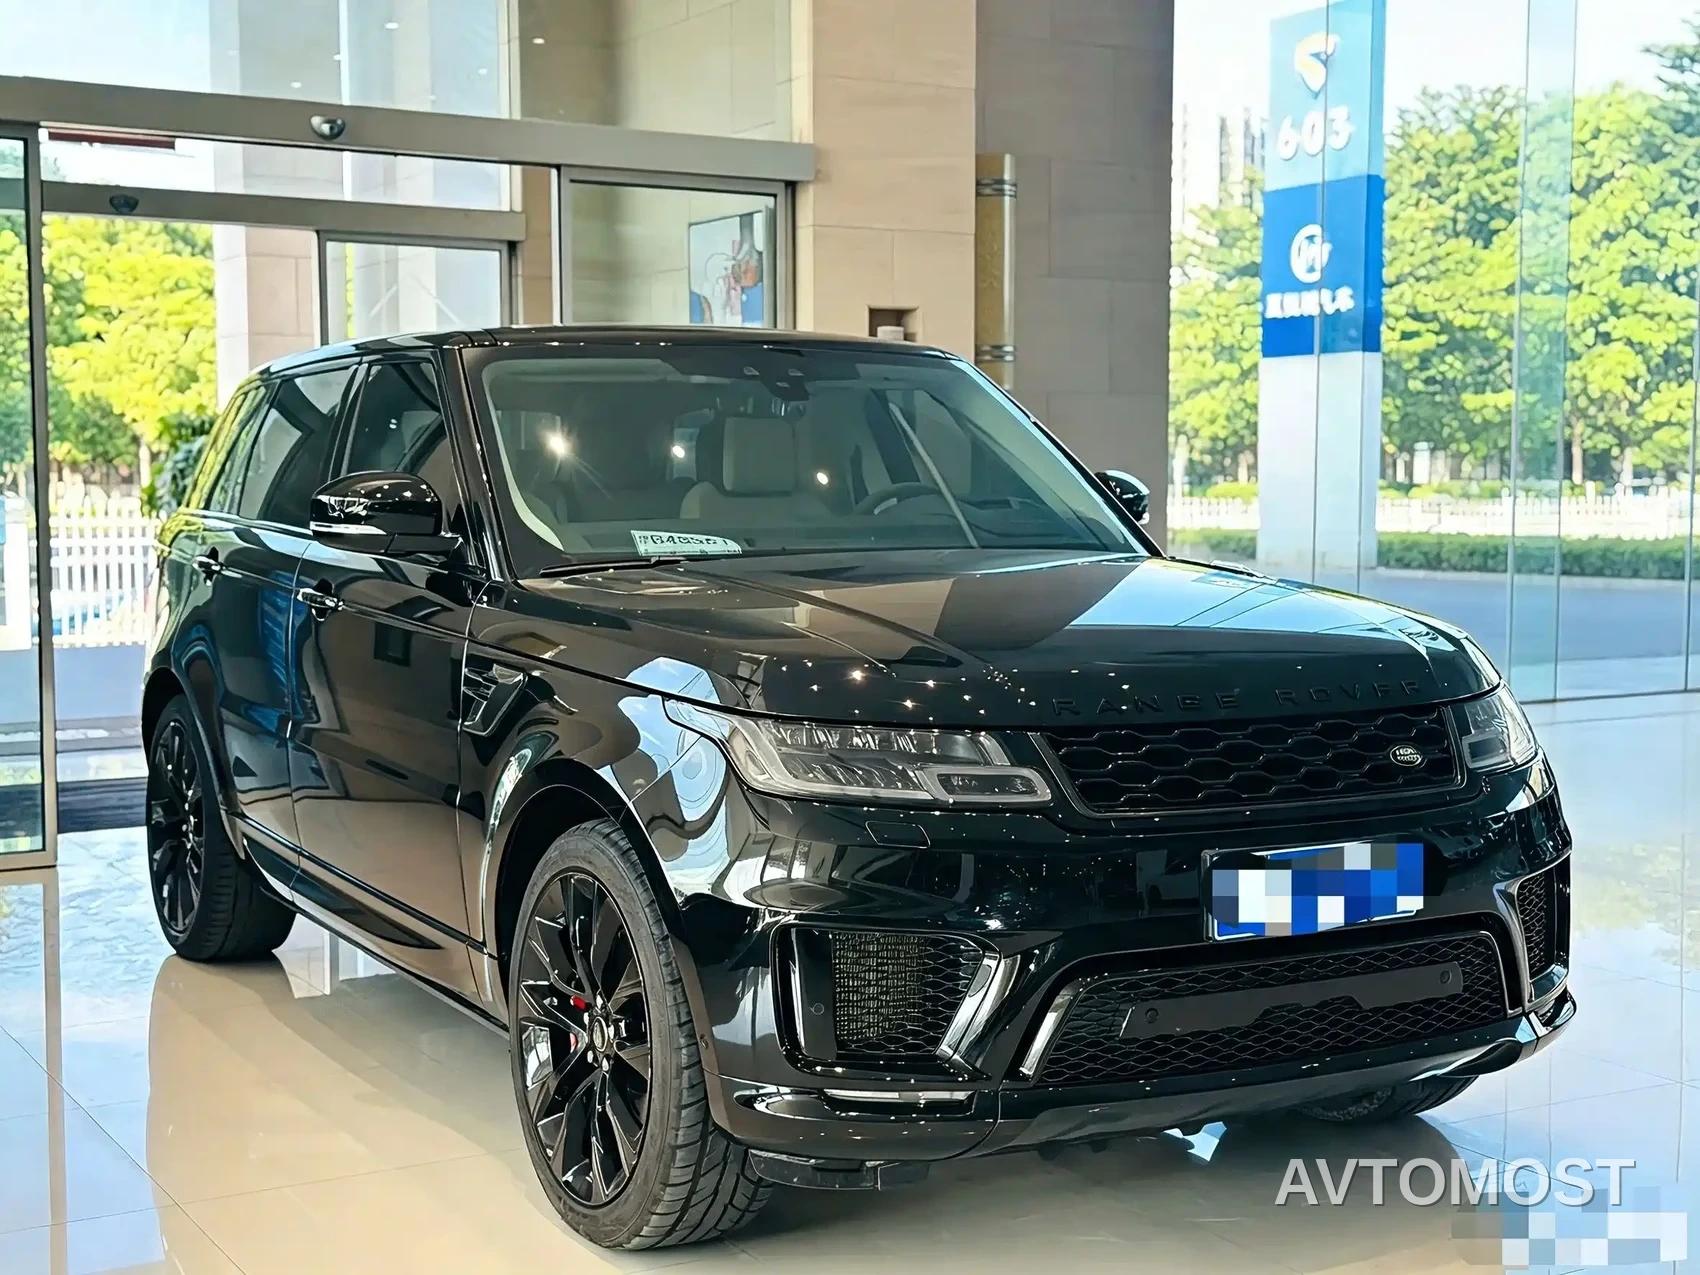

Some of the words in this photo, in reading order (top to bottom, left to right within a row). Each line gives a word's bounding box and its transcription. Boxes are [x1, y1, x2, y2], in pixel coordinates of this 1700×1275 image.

[1277, 105, 1356, 161] 603
[1052, 691, 1240, 717] RANGE
[1274, 679, 1422, 707] ROVER
